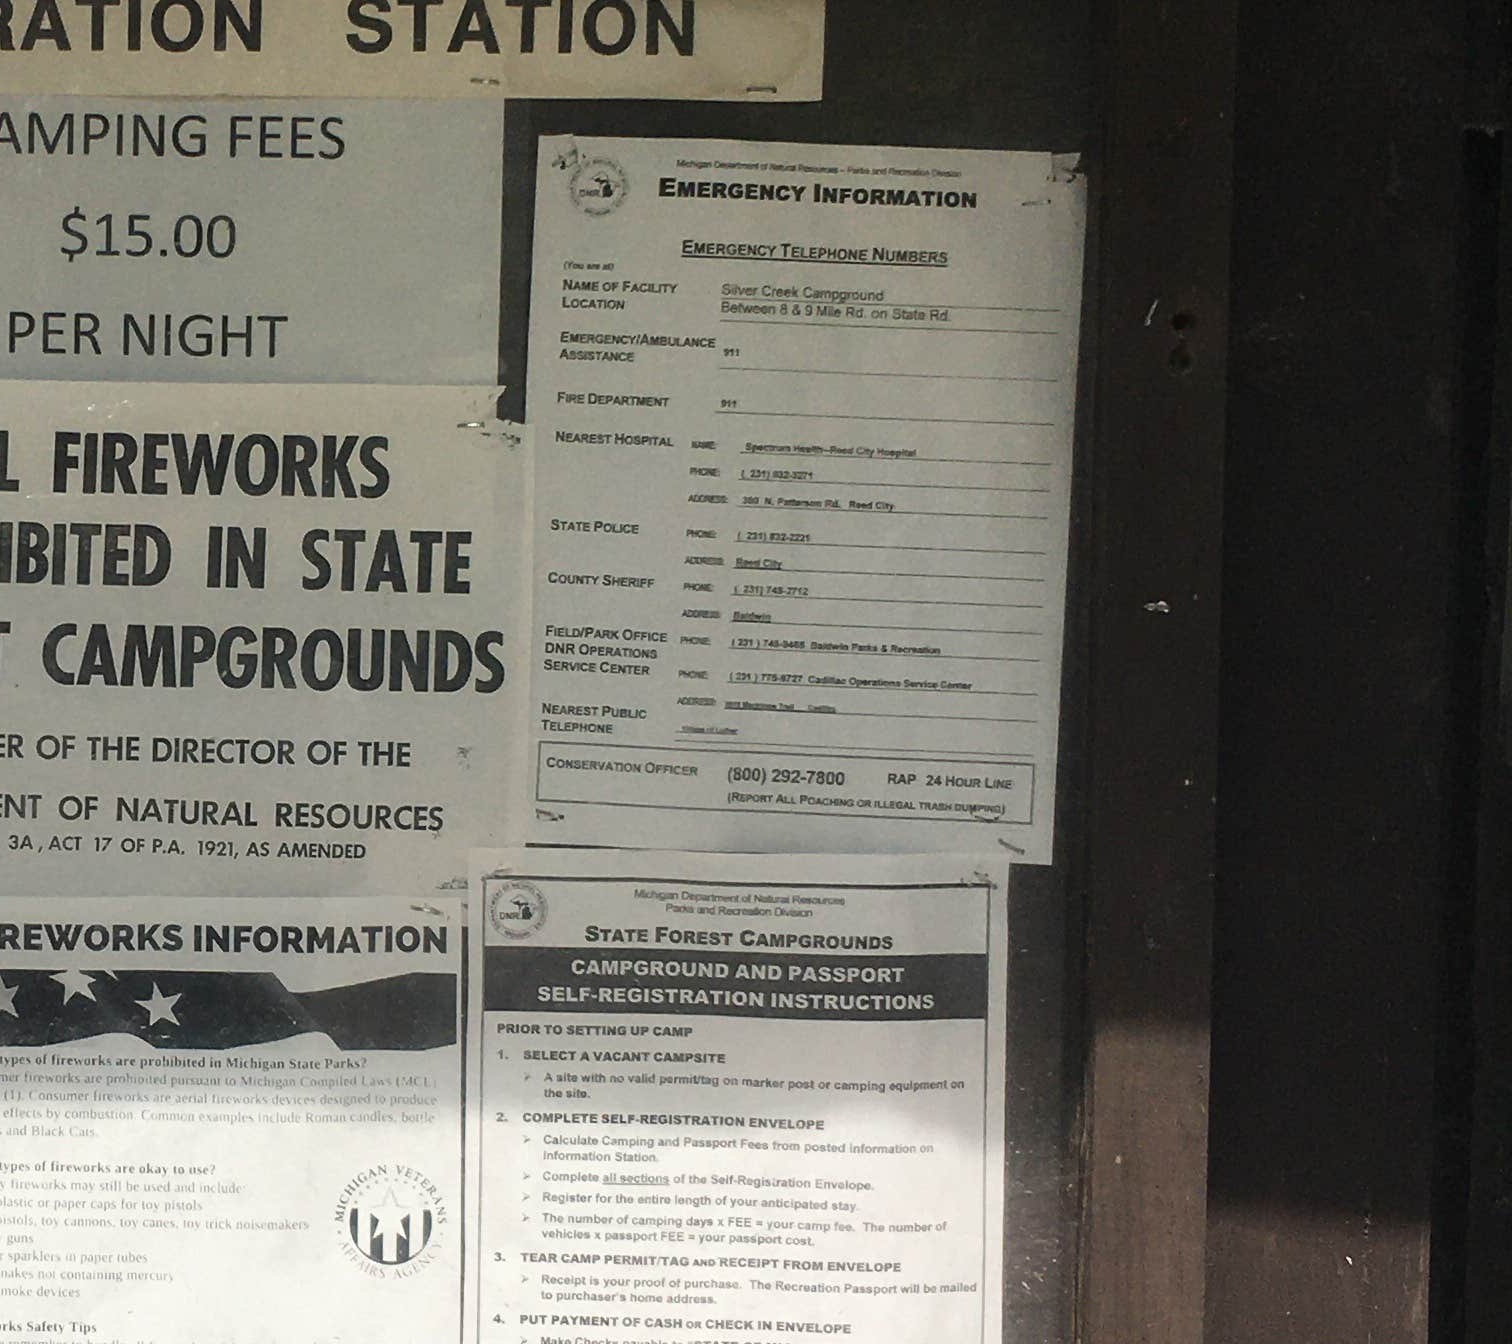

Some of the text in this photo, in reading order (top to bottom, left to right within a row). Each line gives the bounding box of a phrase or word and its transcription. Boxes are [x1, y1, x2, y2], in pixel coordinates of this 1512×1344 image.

[229, 115, 345, 159] FEES
[658, 177, 977, 207] EMERGENCY INFORMATION
[60, 207, 236, 261] $15.00
[561, 278, 678, 293] NAME OF FACILITY
[720, 282, 885, 305] Silver Creek Campground
[561, 296, 626, 310] LOCATION
[8, 311, 289, 357] PER NIGHT
[556, 391, 670, 407] FIRE DEPARTMENT
[52, 432, 390, 497] FIREWORKS
[549, 518, 639, 534] STATE POLICE
[206, 526, 267, 588] IN
[301, 528, 472, 593] STATE
[547, 571, 655, 588] COUNTY SHERIFF
[41, 624, 505, 692] CAMPGROUNDS
[727, 766, 845, 785] (800) 292-7800
[887, 772, 1012, 790] RAP 24 HOUR LINE
[58, 795, 98, 820] OF
[115, 797, 258, 826] NATURAL
[274, 802, 444, 831] RESOURCES
[193, 925, 447, 953] INFORMATION
[584, 924, 893, 949] STATE FOREST CAMPGROUNDS
[570, 959, 905, 982] CAMPGROUND AND PASSPORT
[537, 986, 935, 1010] SELF-REGISTRATION INSTRUCTIONS
[26, 1320, 63, 1333] Safety
[71, 1321, 97, 1335] Tips
